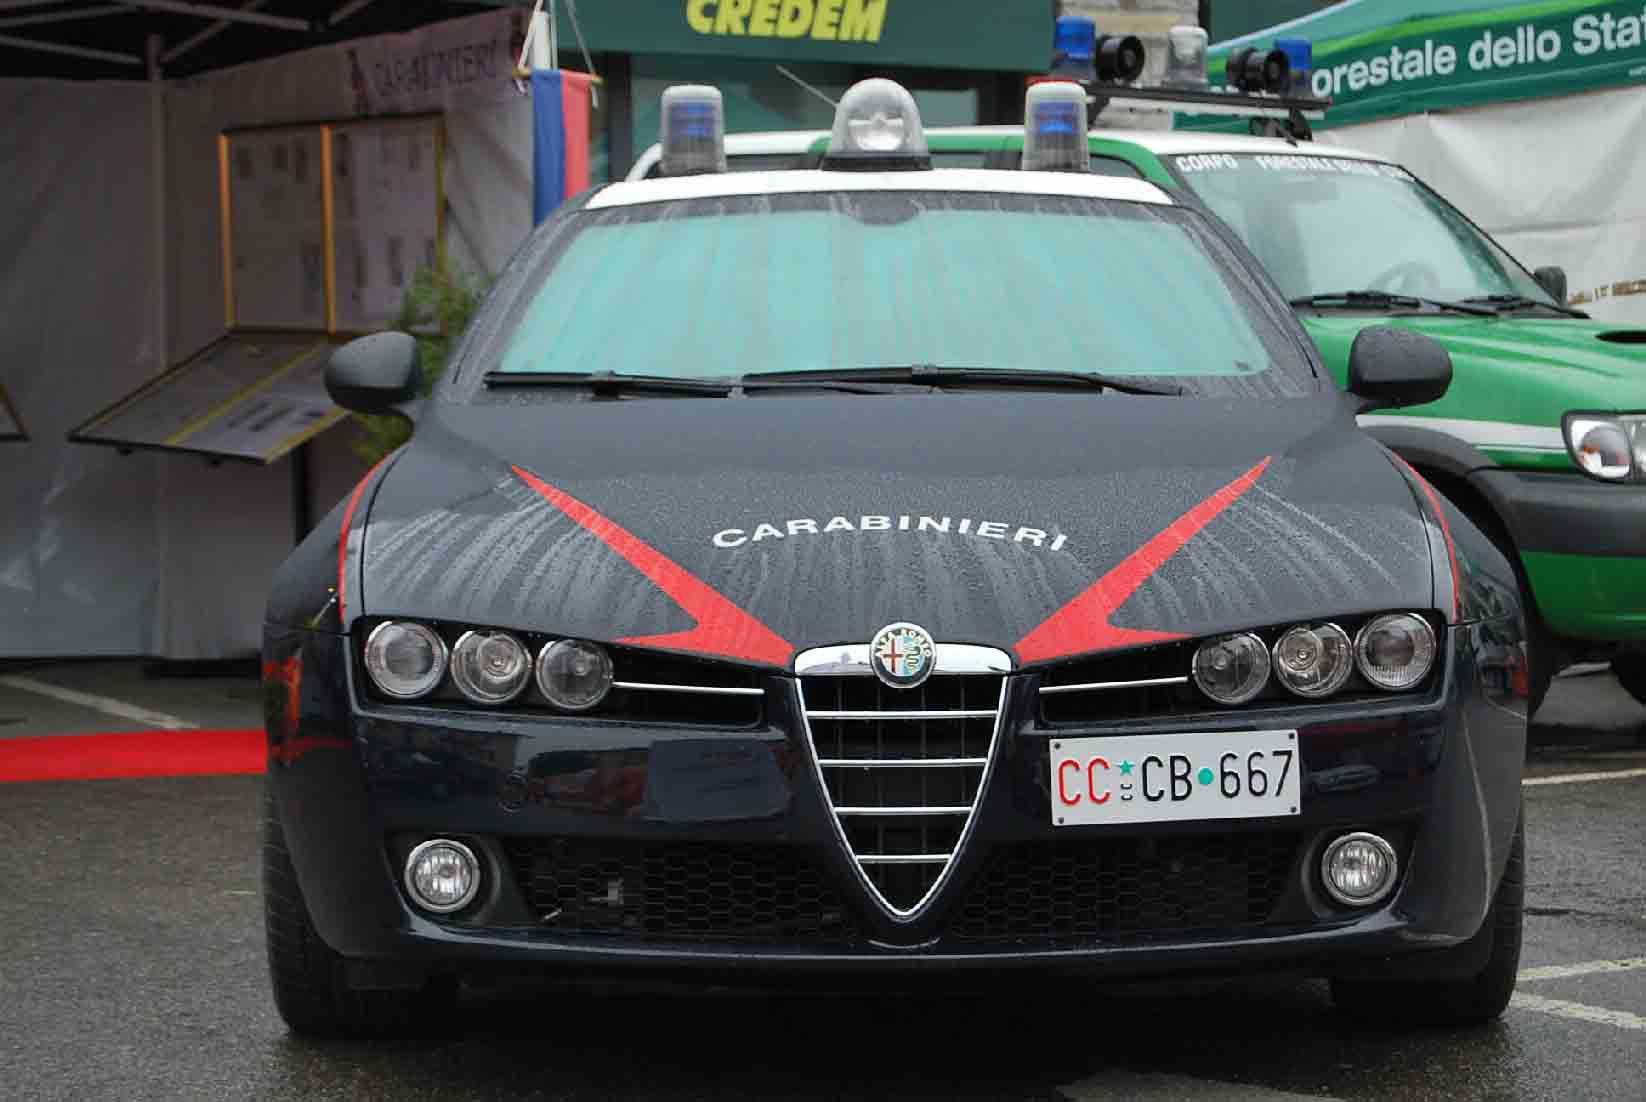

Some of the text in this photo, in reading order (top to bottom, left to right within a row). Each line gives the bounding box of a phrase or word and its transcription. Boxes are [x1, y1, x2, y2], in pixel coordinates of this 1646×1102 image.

[687, 0, 886, 43] CREDEM
[1311, 40, 1457, 98] orestale
[1469, 24, 1561, 67] dello
[1175, 154, 1237, 172] CORPO
[712, 515, 1067, 551] CARABINIERI
[1058, 758, 1111, 806] CC
